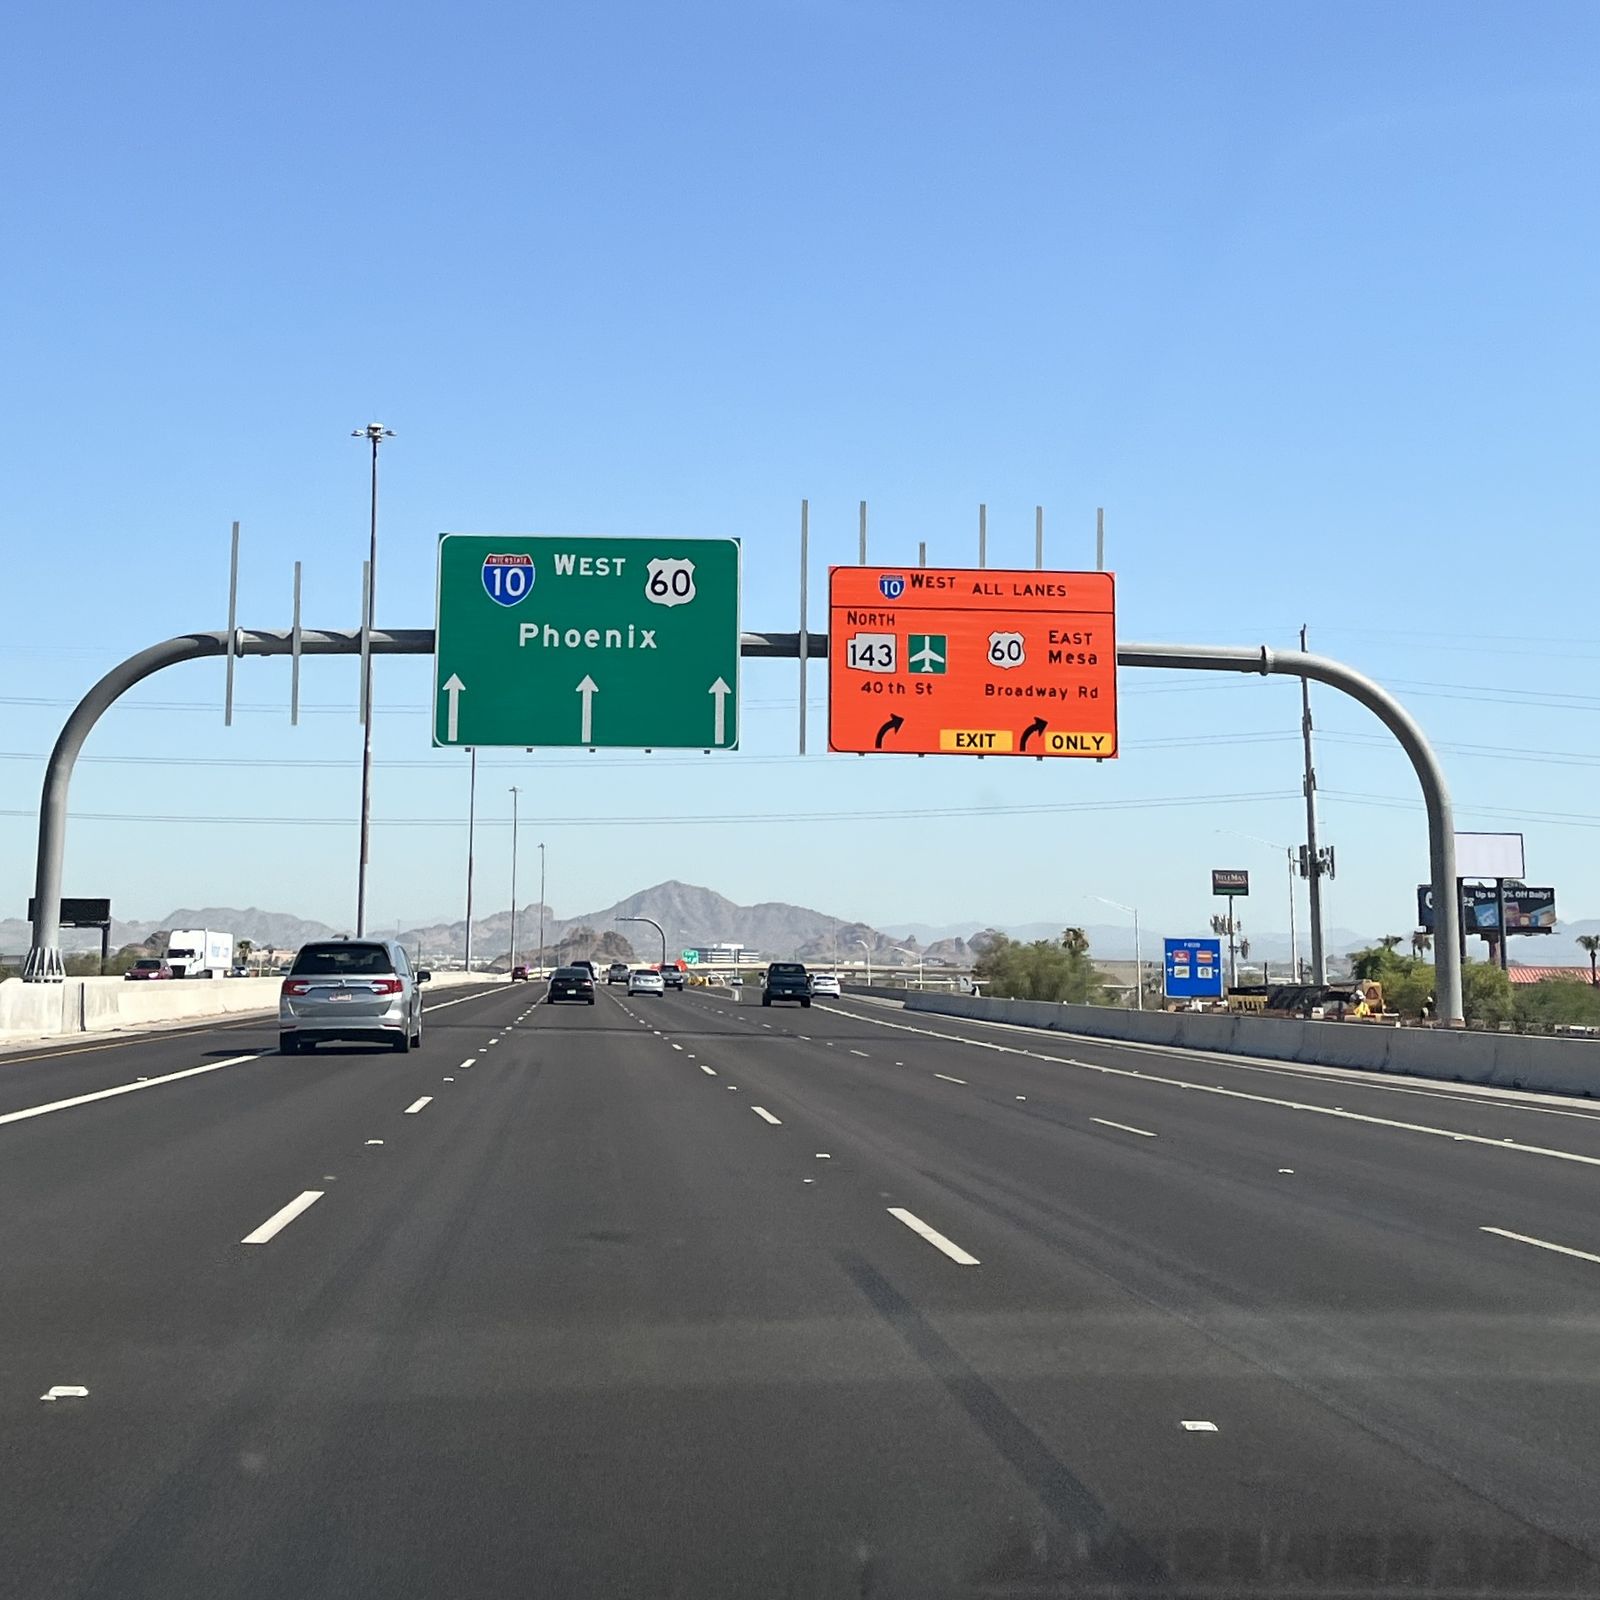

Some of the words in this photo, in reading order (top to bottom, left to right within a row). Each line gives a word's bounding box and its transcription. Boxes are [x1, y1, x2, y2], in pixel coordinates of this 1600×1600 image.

[489, 557, 528, 565] INTERSTATE
[554, 554, 625, 576] WEST
[493, 567, 525, 597] 10
[651, 569, 691, 597] 60
[883, 581, 901, 596] 10
[910, 574, 956, 589] WEST
[972, 583, 1004, 596] ALL
[1013, 584, 1067, 597] LANES
[847, 611, 896, 626] NORTH
[519, 623, 657, 649] Phoenix
[1049, 630, 1094, 646] EAST
[849, 643, 893, 667] 143
[991, 639, 1022, 662] 60
[1049, 650, 1098, 665] Mesa
[860, 681, 906, 695] 40th
[915, 682, 933, 695] St
[985, 684, 1068, 701] Broadway
[1079, 685, 1099, 699] Rd
[956, 732, 996, 748] EXIT
[1052, 735, 1105, 751] ONLY
[1475, 891, 1486, 899] Up
